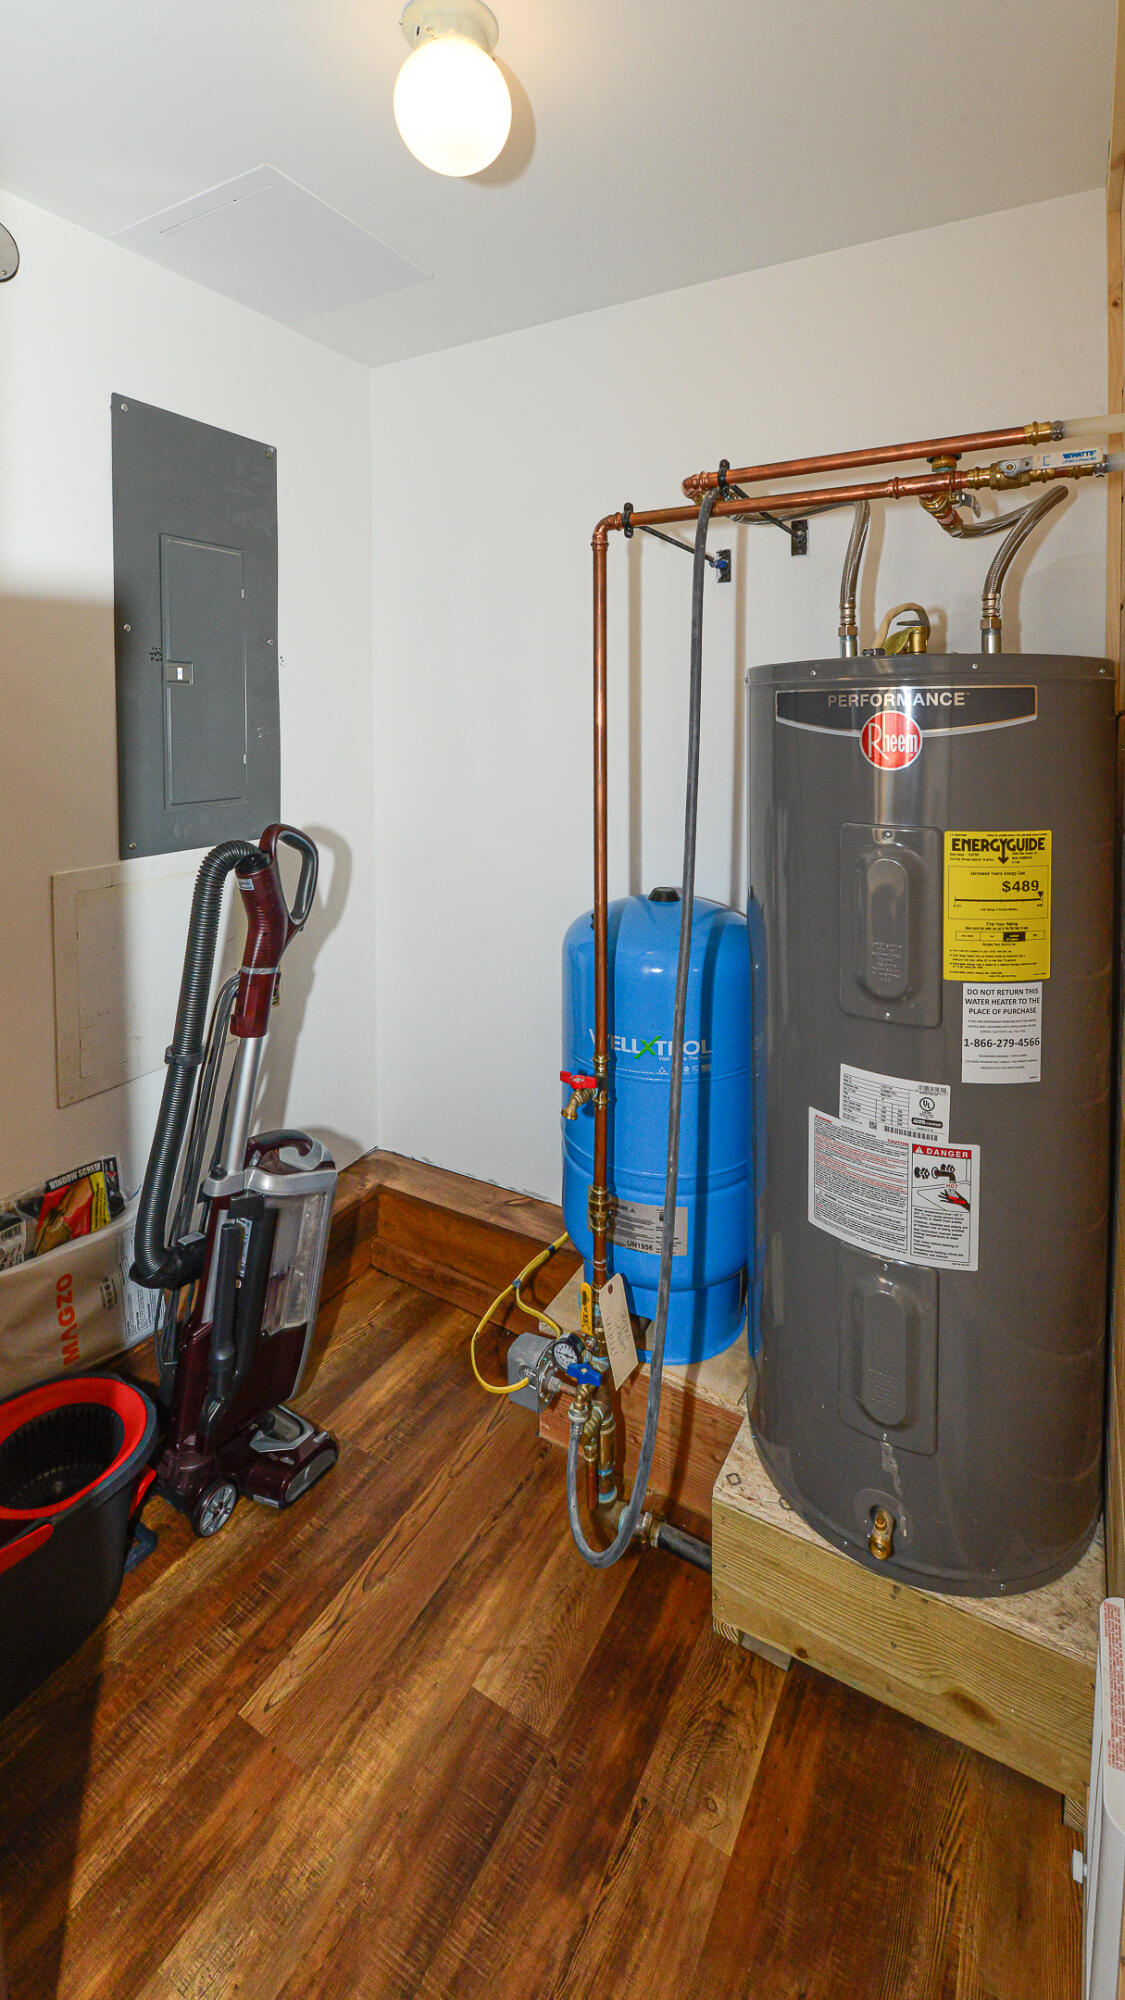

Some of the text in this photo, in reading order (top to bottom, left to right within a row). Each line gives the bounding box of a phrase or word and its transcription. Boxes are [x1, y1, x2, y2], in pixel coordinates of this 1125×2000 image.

[828, 692, 966, 707] PERFORMANCE
[868, 723, 918, 760] Rheem
[952, 838, 1046, 852] ENERGYGUIDE
[1002, 880, 1039, 892] $489
[964, 1037, 1040, 1047] 1-866-279-4566
[927, 1147, 969, 1158] DANGER
[49, 1170, 78, 1190] WINDOW
